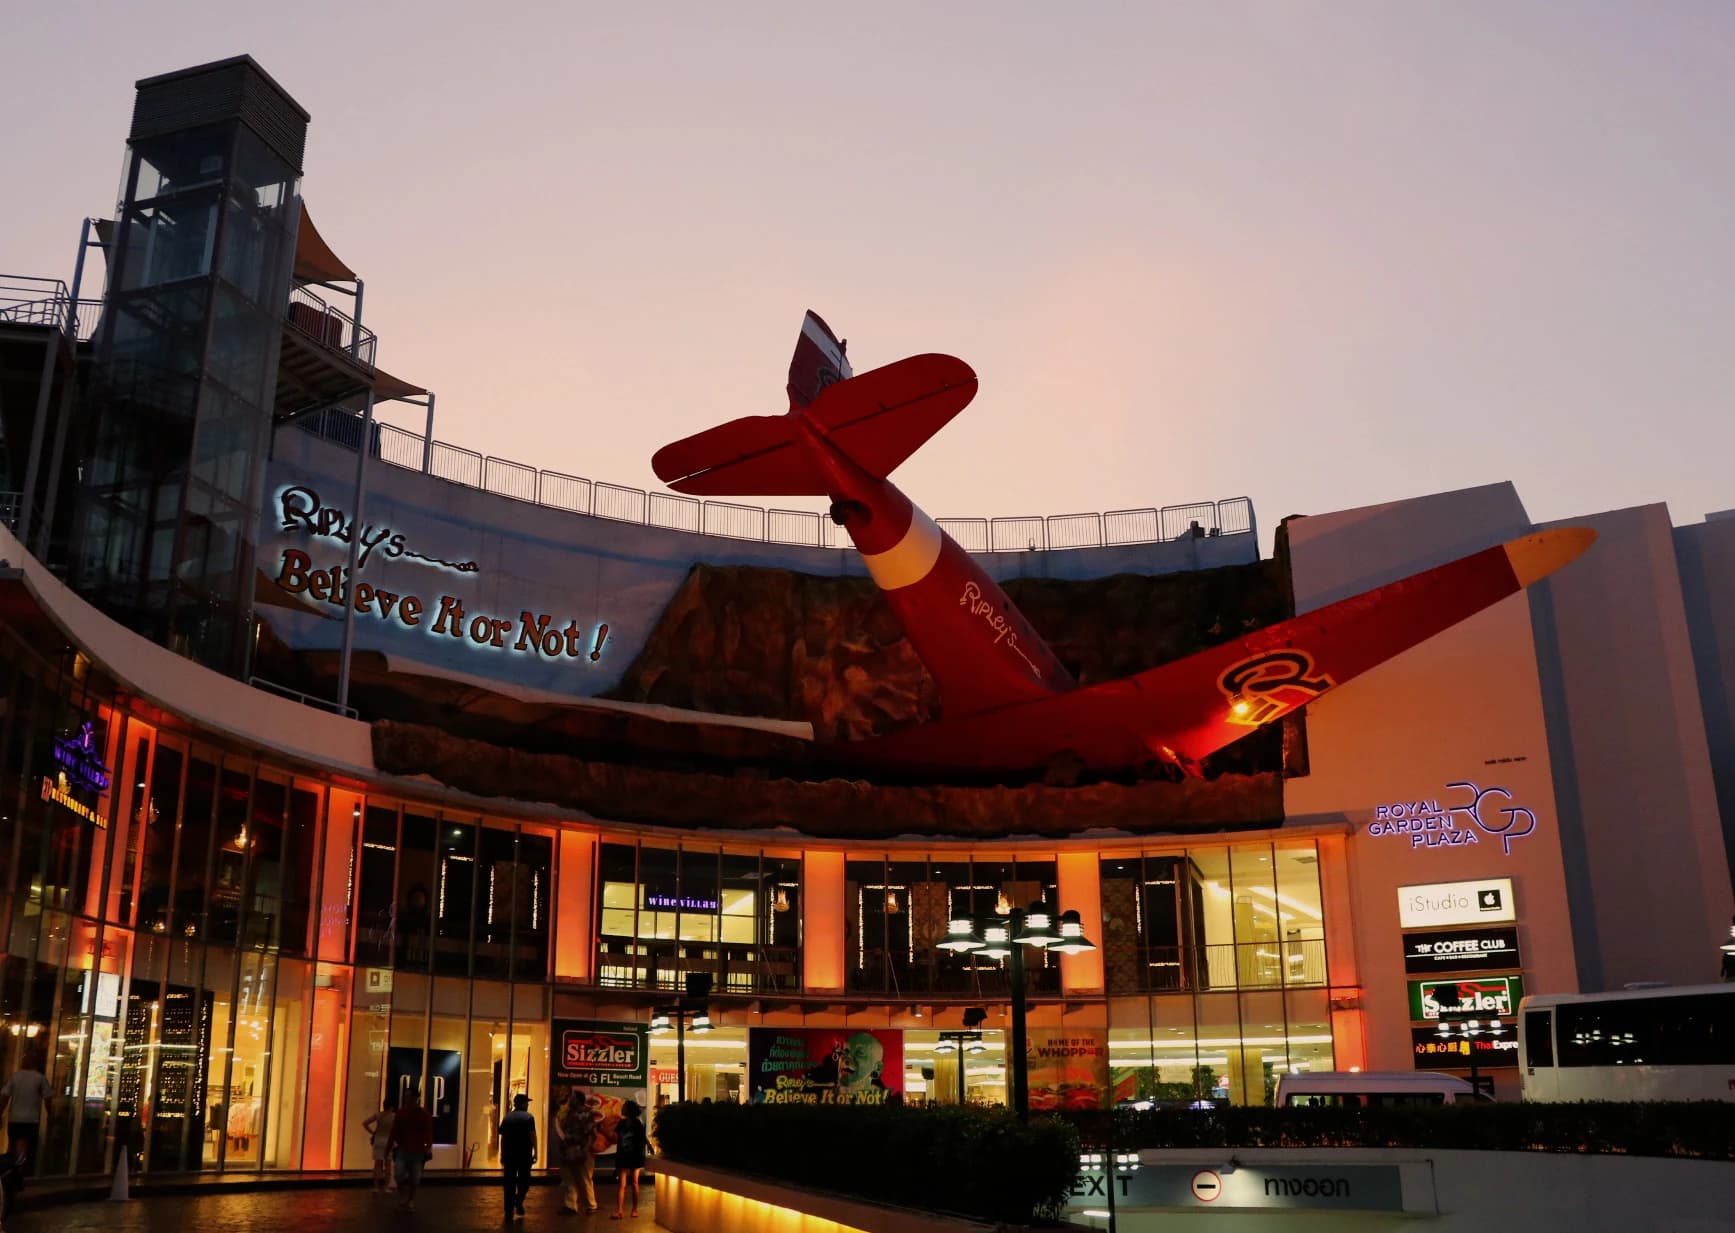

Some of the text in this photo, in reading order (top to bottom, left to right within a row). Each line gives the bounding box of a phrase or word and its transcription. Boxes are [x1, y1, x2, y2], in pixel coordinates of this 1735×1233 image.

[281, 486, 406, 569] Riply's
[431, 595, 465, 638] It
[470, 615, 513, 648] or
[1376, 800, 1444, 820] ROYAL
[1368, 815, 1453, 836] GARDEN
[1411, 829, 1478, 848] PLAZA
[1409, 894, 1469, 912] iStudio
[1433, 940, 1480, 953] COFFEE
[1480, 939, 1506, 950] CLUB
[1423, 991, 1508, 1014] Szler
[567, 1043, 635, 1063] Sizzler
[1474, 1040, 1519, 1051] ThaiExpre
[399, 1073, 446, 1118] GP
[763, 1088, 818, 1105] Believe
[1070, 1175, 1133, 1196] EXT
